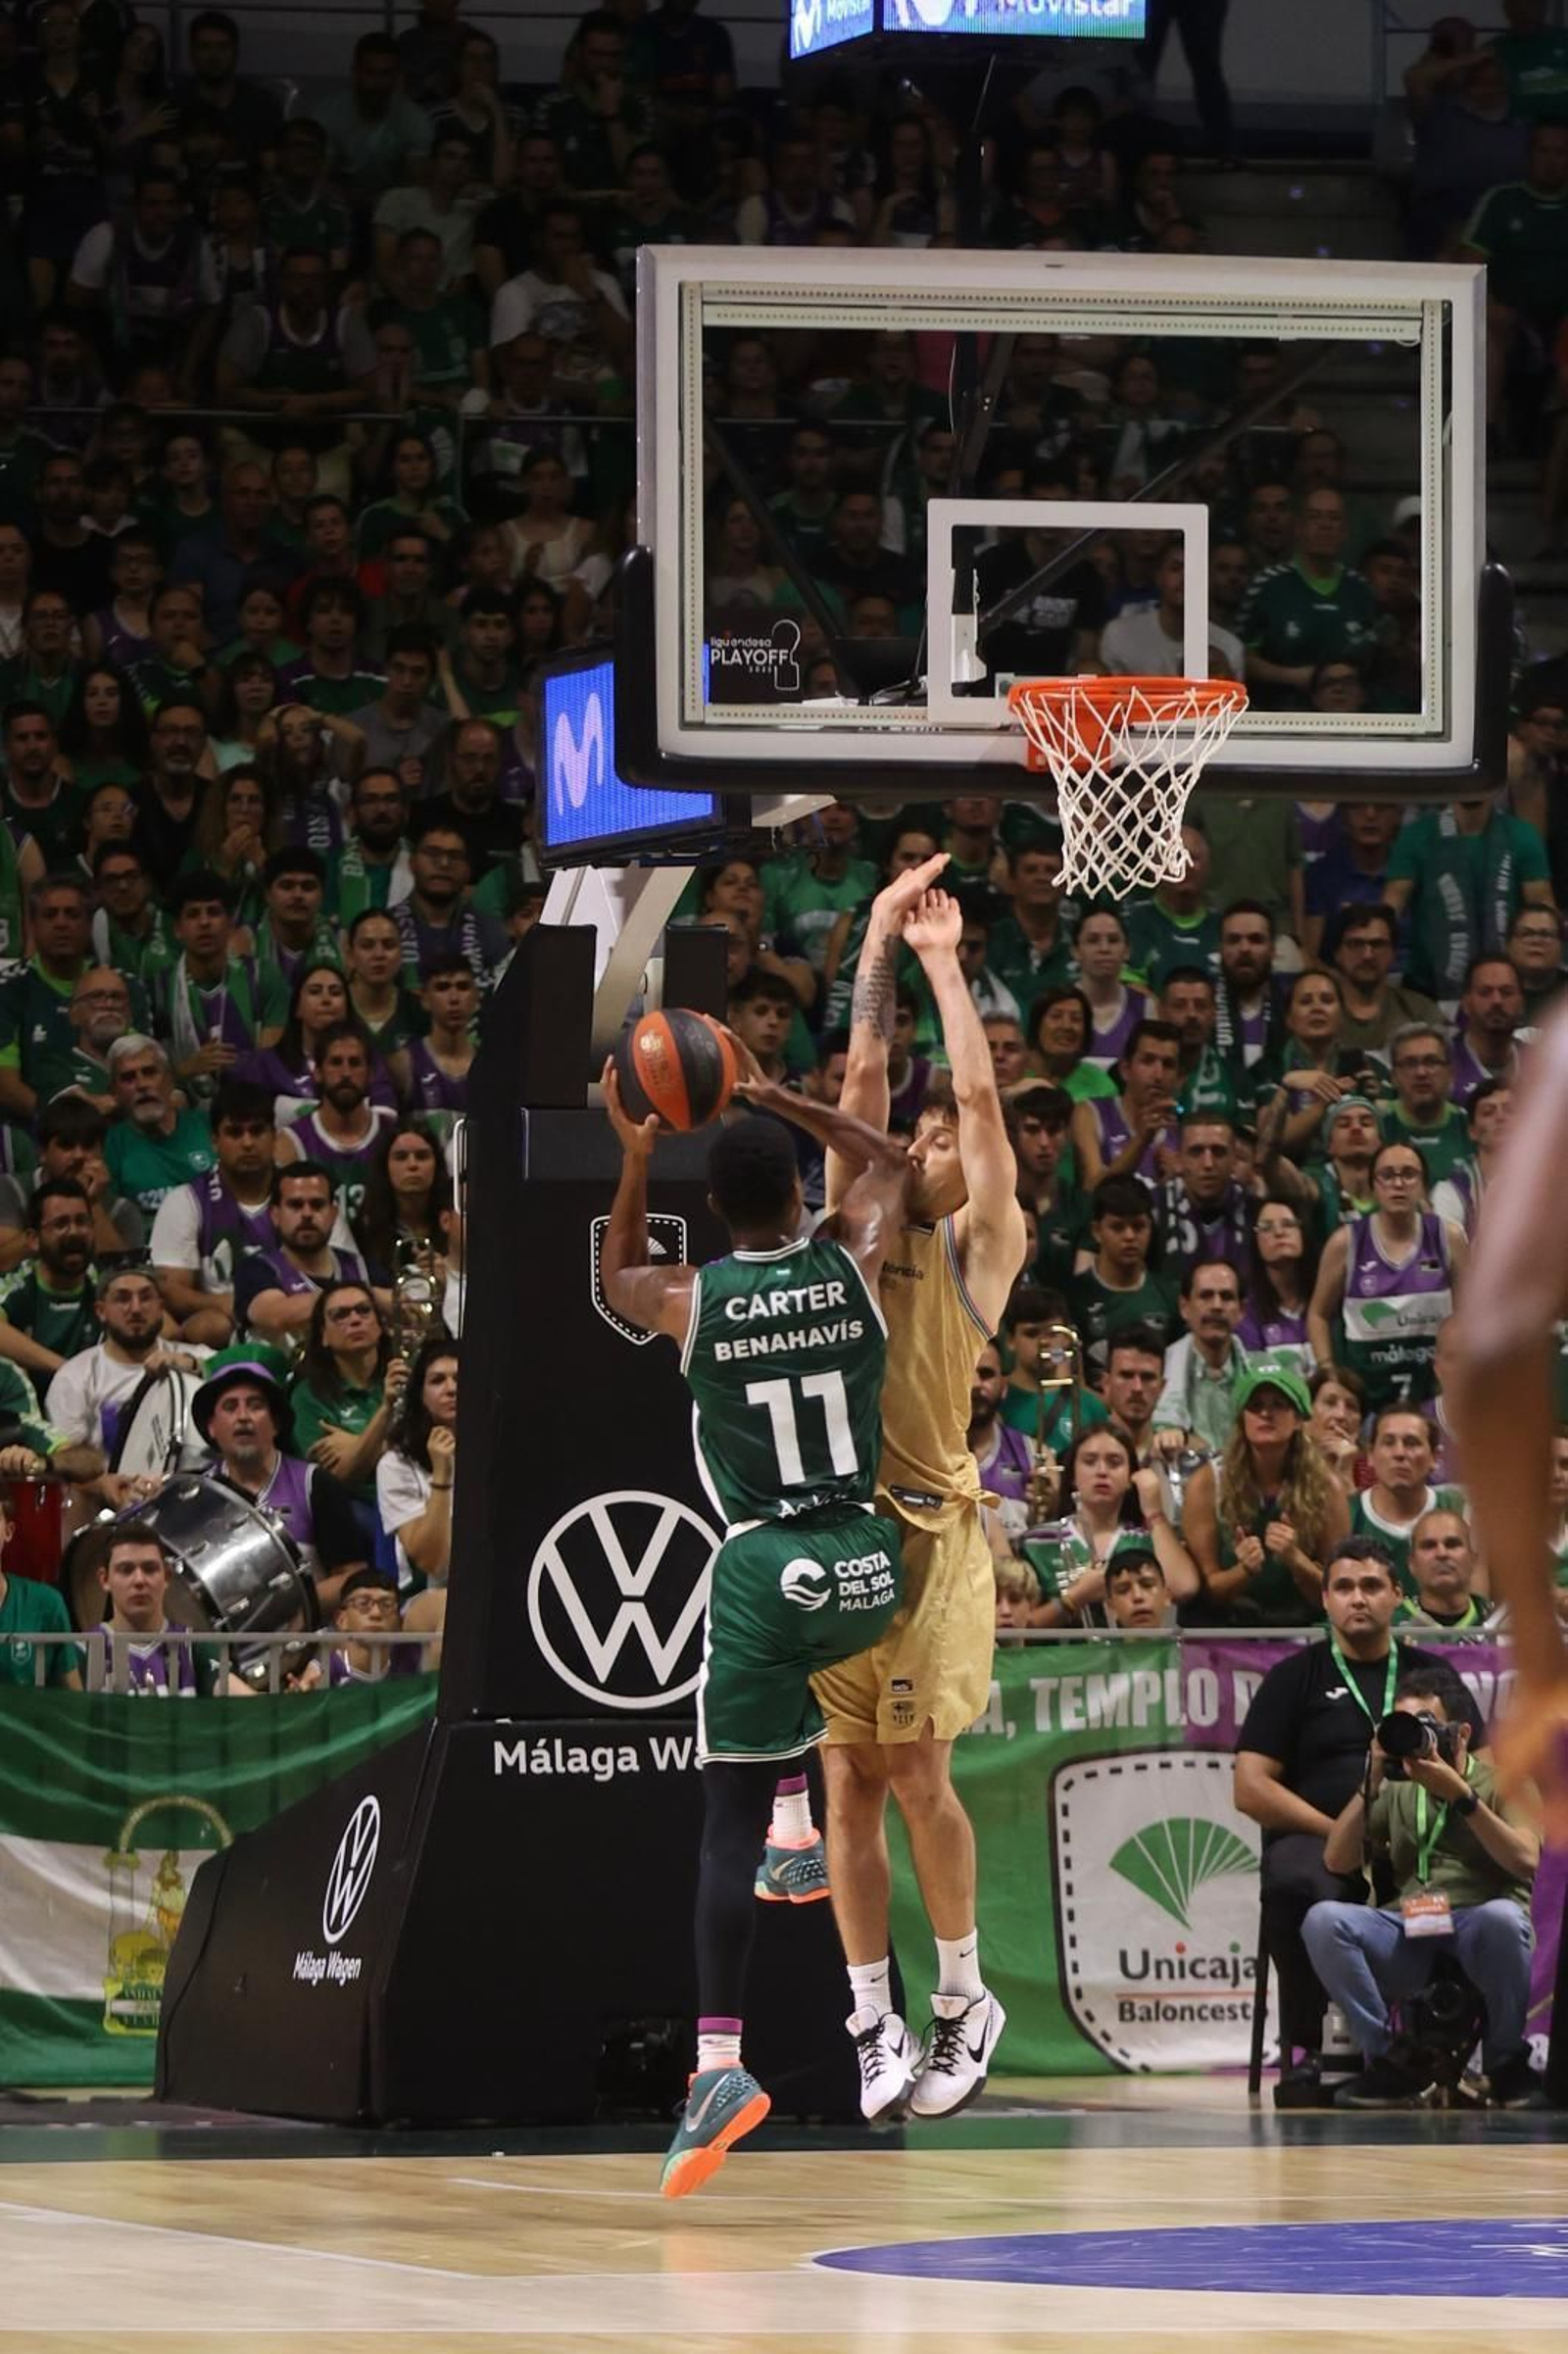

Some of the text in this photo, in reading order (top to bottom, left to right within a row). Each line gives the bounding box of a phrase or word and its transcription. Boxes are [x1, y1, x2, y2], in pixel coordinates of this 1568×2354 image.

[710, 648, 789, 666] PLAYOFF
[724, 1280, 848, 1322] CARTER
[713, 1319, 864, 1362] BENAHAVÍS
[1391, 1373, 1413, 1400] 7
[745, 1369, 859, 1487] 11
[833, 1549, 892, 1579] COSTA
[838, 1570, 895, 1596] DEL SOL
[1030, 1667, 1219, 1734] TEMPLO
[493, 1738, 641, 1783] Málaga
[325, 1950, 362, 1987] Wagen
[1118, 1941, 1259, 1988] Unicaja
[1117, 1998, 1268, 2024] Baloncest
